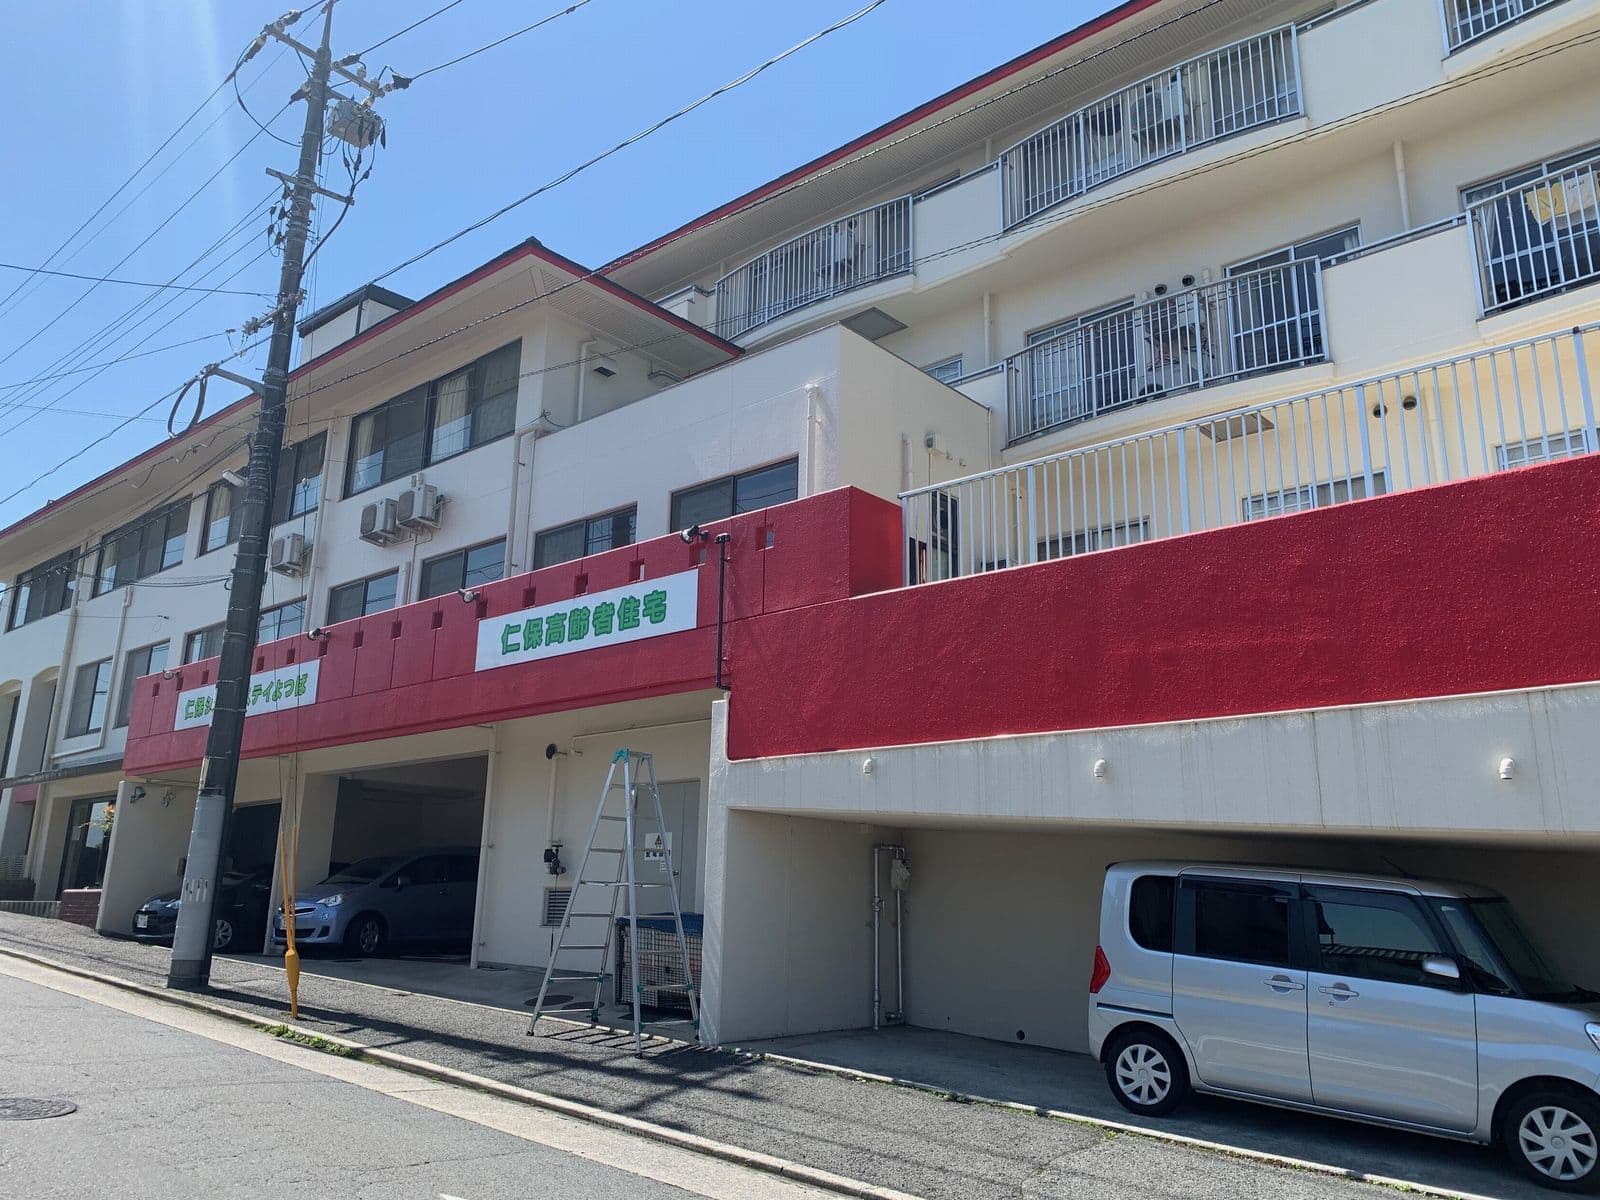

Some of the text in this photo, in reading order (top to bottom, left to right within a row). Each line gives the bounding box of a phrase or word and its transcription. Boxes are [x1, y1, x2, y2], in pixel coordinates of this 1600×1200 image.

[501, 590, 667, 655] 仁保高齢者住宅
